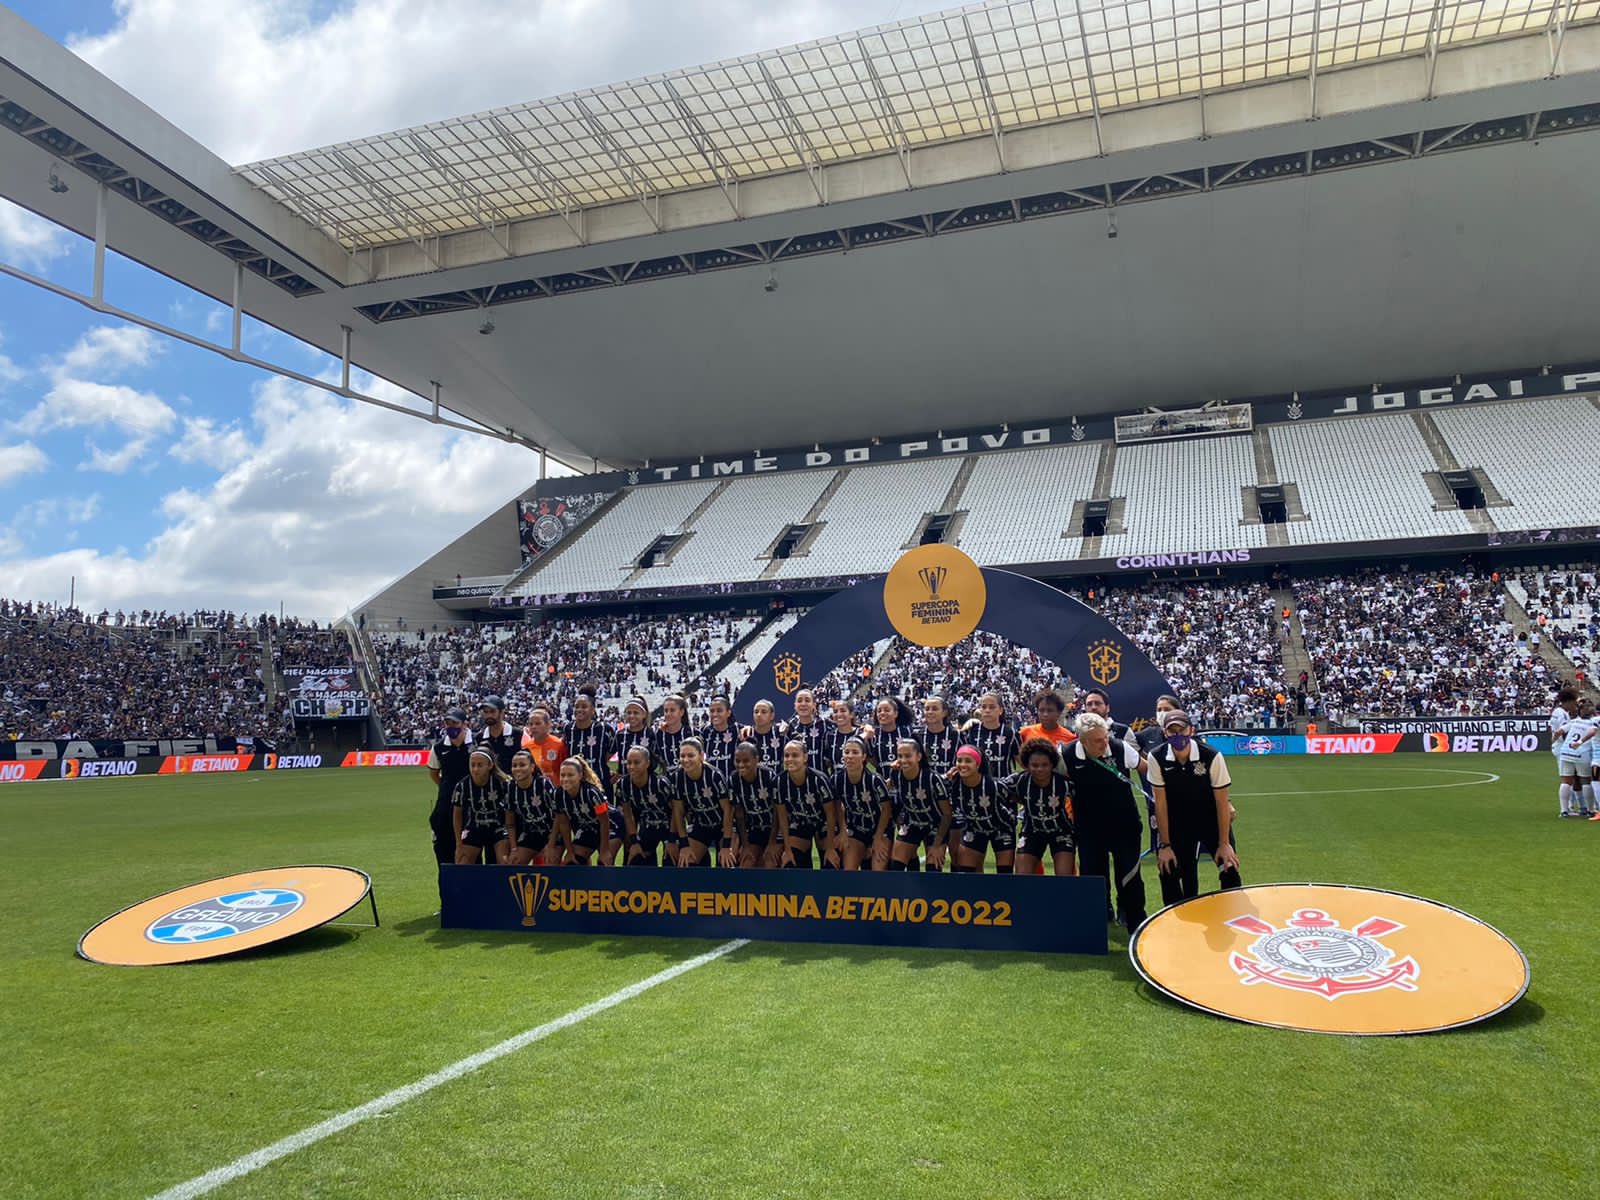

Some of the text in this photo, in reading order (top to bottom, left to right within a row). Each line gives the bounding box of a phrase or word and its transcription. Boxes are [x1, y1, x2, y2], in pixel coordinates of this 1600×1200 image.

[1333, 379, 1525, 414] JOGAI
[655, 428, 1050, 480] TIME DO POVO
[1116, 549, 1251, 570] CORINTHIANS
[911, 600, 960, 611] SUPERCOPA
[911, 607, 960, 618] FEMININA
[921, 615, 952, 625] BETANO
[1380, 722, 1403, 734] SER
[1406, 720, 1489, 735] CORINTHIANO
[122, 739, 237, 757] FIEL
[1452, 734, 1539, 753] BETANO
[191, 758, 239, 772] BETANO
[277, 754, 322, 769] BETANO
[374, 752, 422, 767] BETANO
[80, 760, 137, 777] BETANO
[548, 888, 1012, 926] SUPERCOPA FEMININA BETANO 2022
